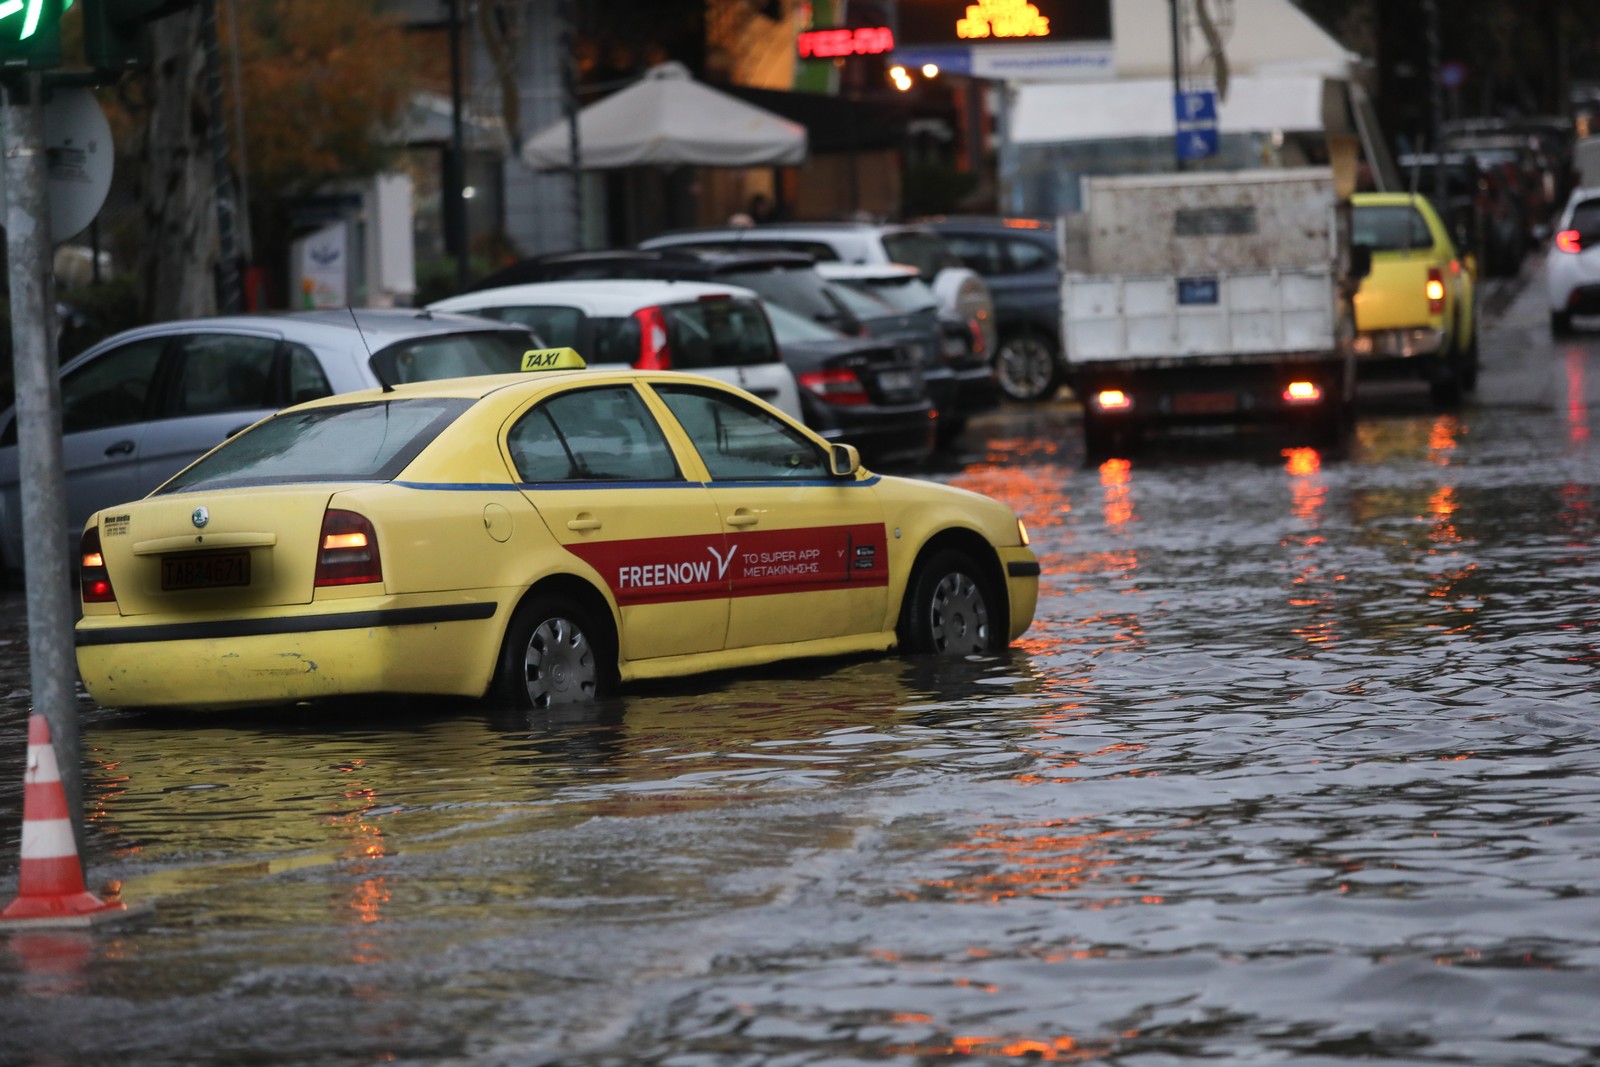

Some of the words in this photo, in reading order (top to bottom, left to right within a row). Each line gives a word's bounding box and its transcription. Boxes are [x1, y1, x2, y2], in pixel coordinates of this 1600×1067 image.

[1185, 95, 1205, 119] P
[526, 352, 560, 368] TAXI
[760, 550, 797, 563] SUPER
[798, 549, 820, 560] APP
[619, 560, 711, 589] FREENOW
[743, 562, 819, 577] ΜΕΤΑΚΙΝΗΣΗΣ
